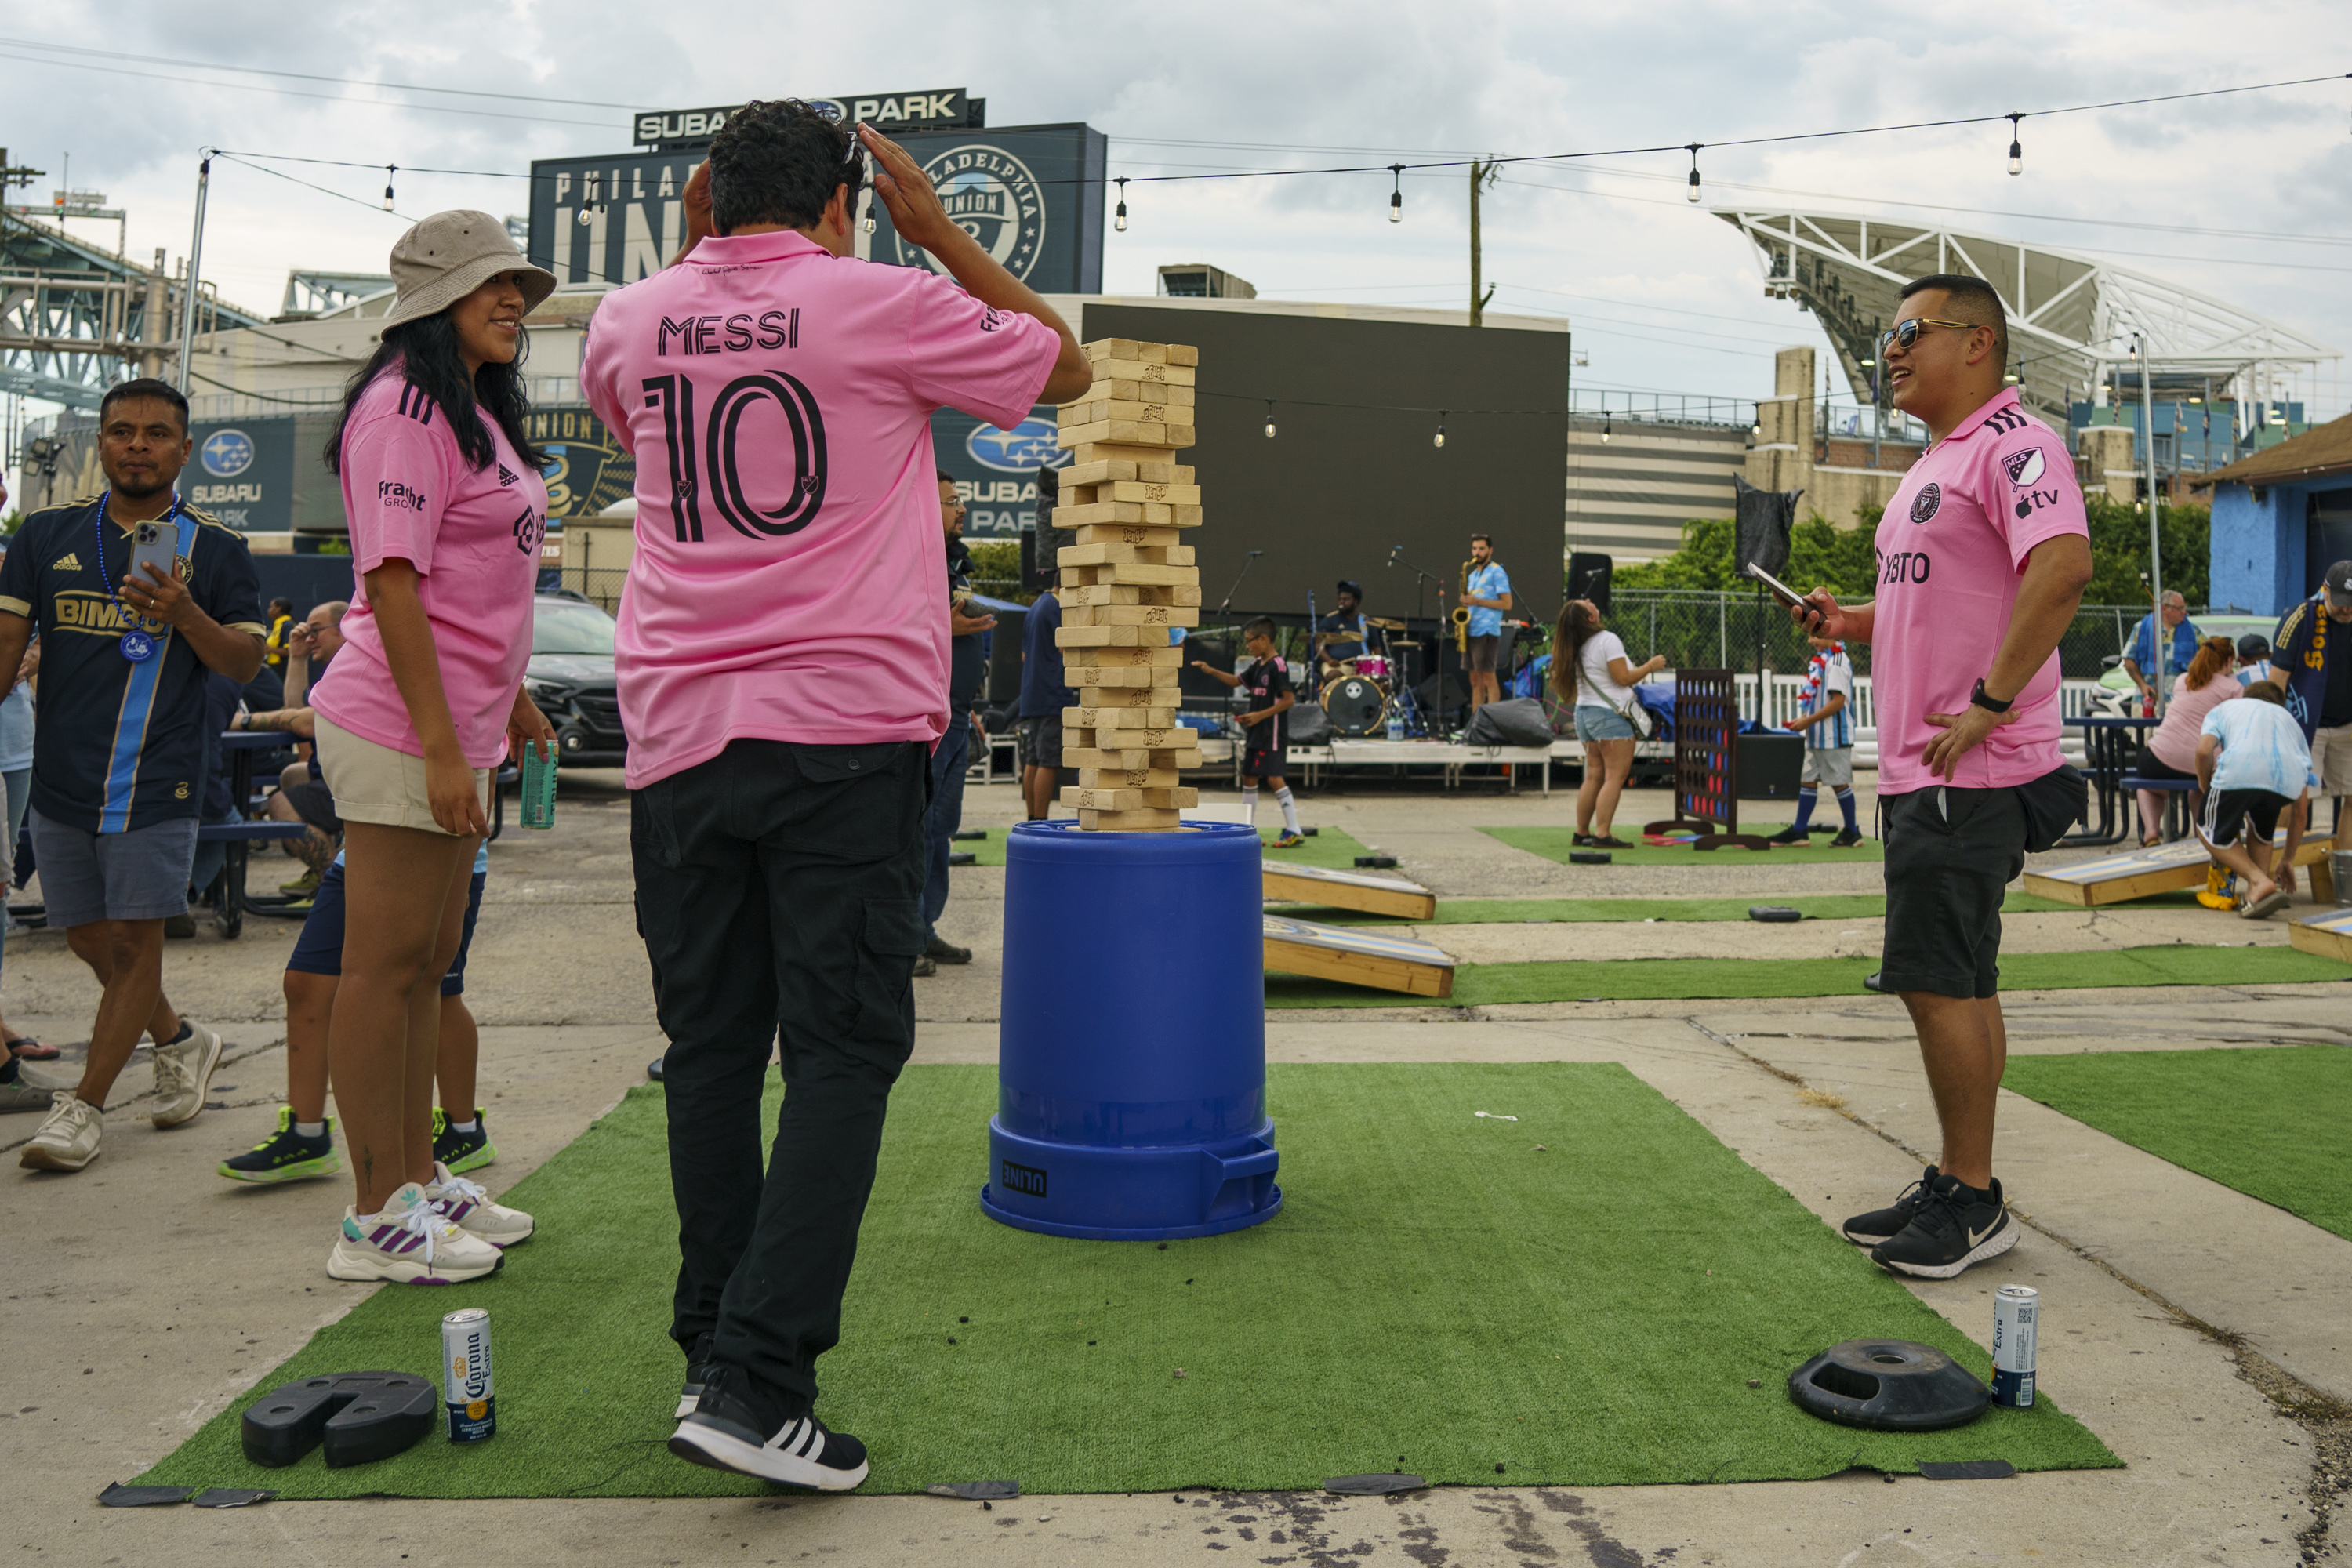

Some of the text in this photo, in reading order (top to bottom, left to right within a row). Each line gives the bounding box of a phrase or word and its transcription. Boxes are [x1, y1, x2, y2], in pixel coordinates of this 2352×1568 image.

[638, 93, 956, 140] SUBA PARK
[929, 153, 1037, 220] LADELPHIA
[944, 194, 997, 214] UNION
[658, 308, 800, 356] MESSI
[642, 370, 828, 543] 10
[2007, 453, 2027, 468] MLS
[192, 483, 262, 504] SUBARU
[500, 474, 520, 487] adidas
[953, 481, 1036, 503] SUBA
[1145, 485, 1167, 501] Jenga
[379, 480, 426, 512] Fracht
[2031, 489, 2059, 509] tv
[1123, 528, 1145, 544] Jenga
[1883, 552, 1930, 585] XBTO
[1143, 731, 1164, 746] Jenga
[1004, 1164, 1044, 1192] ULINE
[1994, 1319, 2003, 1349] Extra
[465, 1332, 485, 1399] Corona
[482, 1345, 492, 1379] Extra
